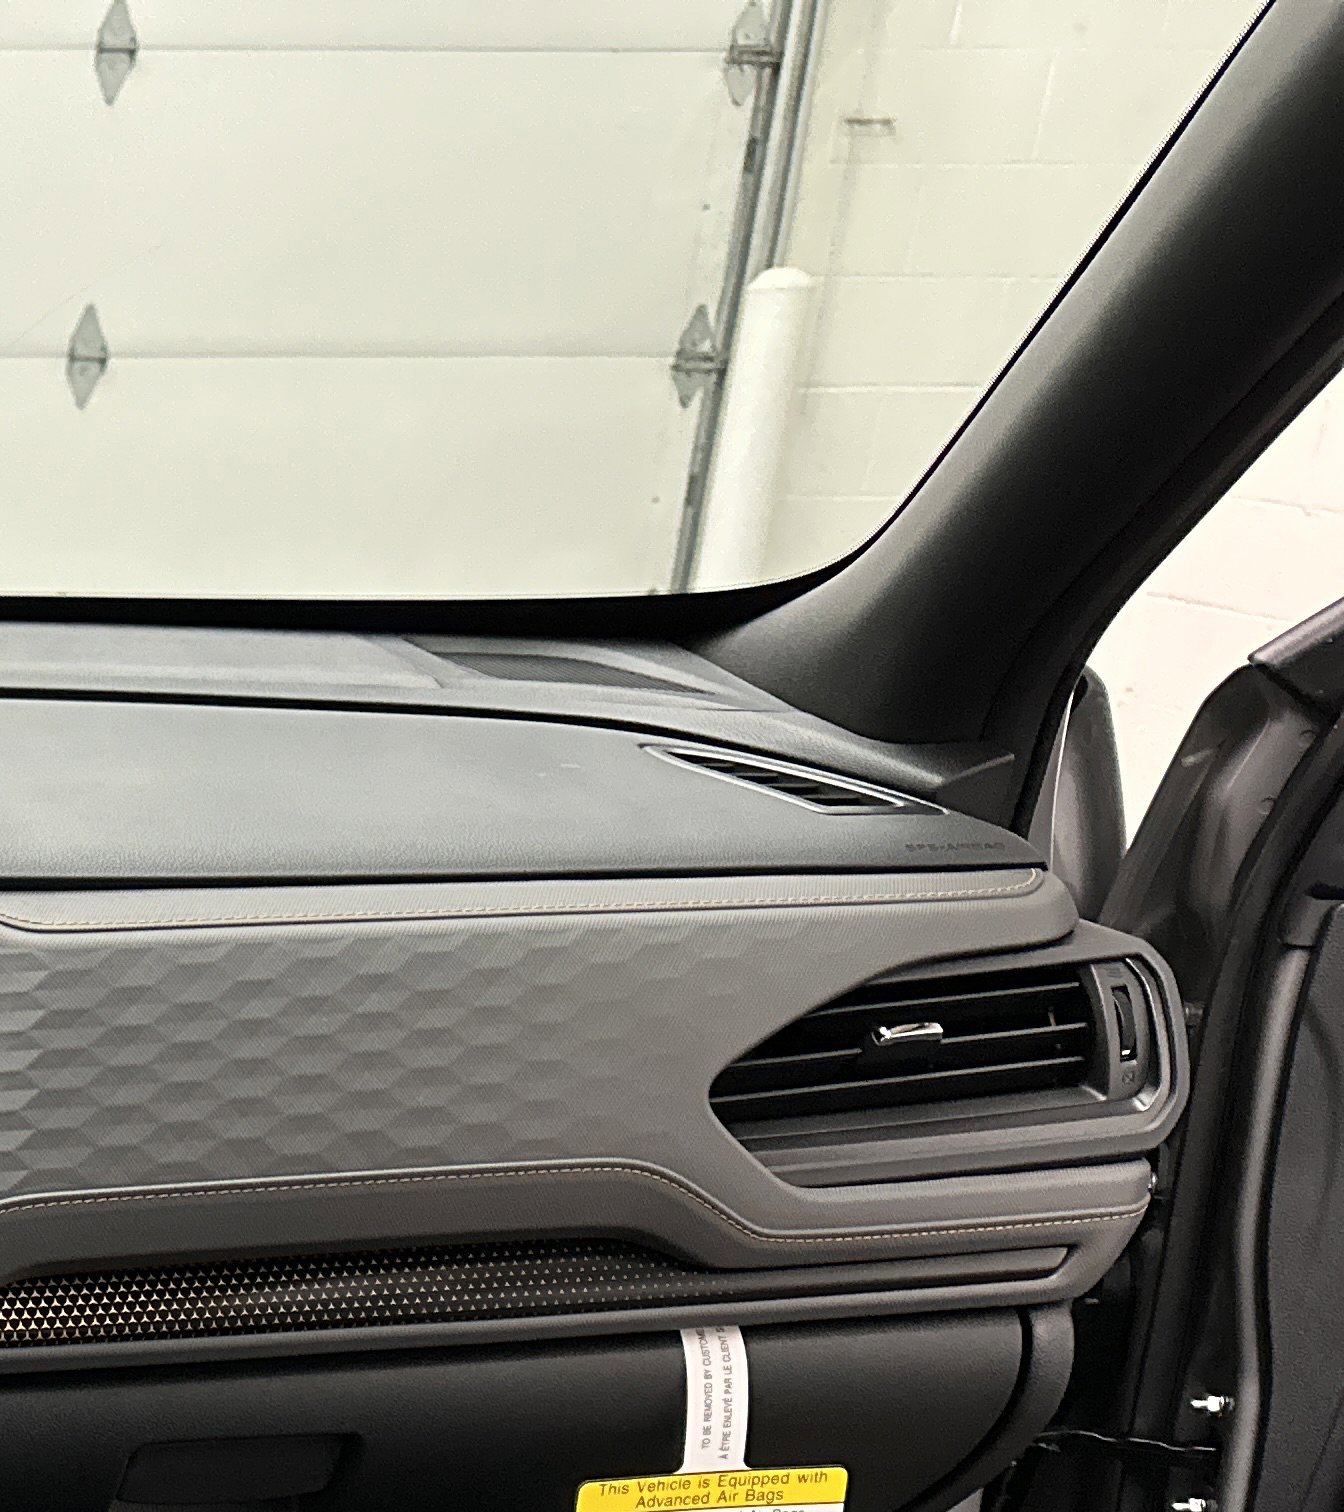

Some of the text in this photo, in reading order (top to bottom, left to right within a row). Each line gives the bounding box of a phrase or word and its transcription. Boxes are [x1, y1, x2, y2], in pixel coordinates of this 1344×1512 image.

[704, 1369, 713, 1380] BY
[723, 1365, 732, 1375] LE
[724, 1379, 733, 1395] PAR
[703, 1382, 713, 1422] REMOVED
[703, 1426, 712, 1436] BE
[702, 1438, 711, 1449] TO
[600, 1472, 827, 1496] This Vehicle is Equipped with
[636, 1490, 783, 1509] Advanced Air Bags
